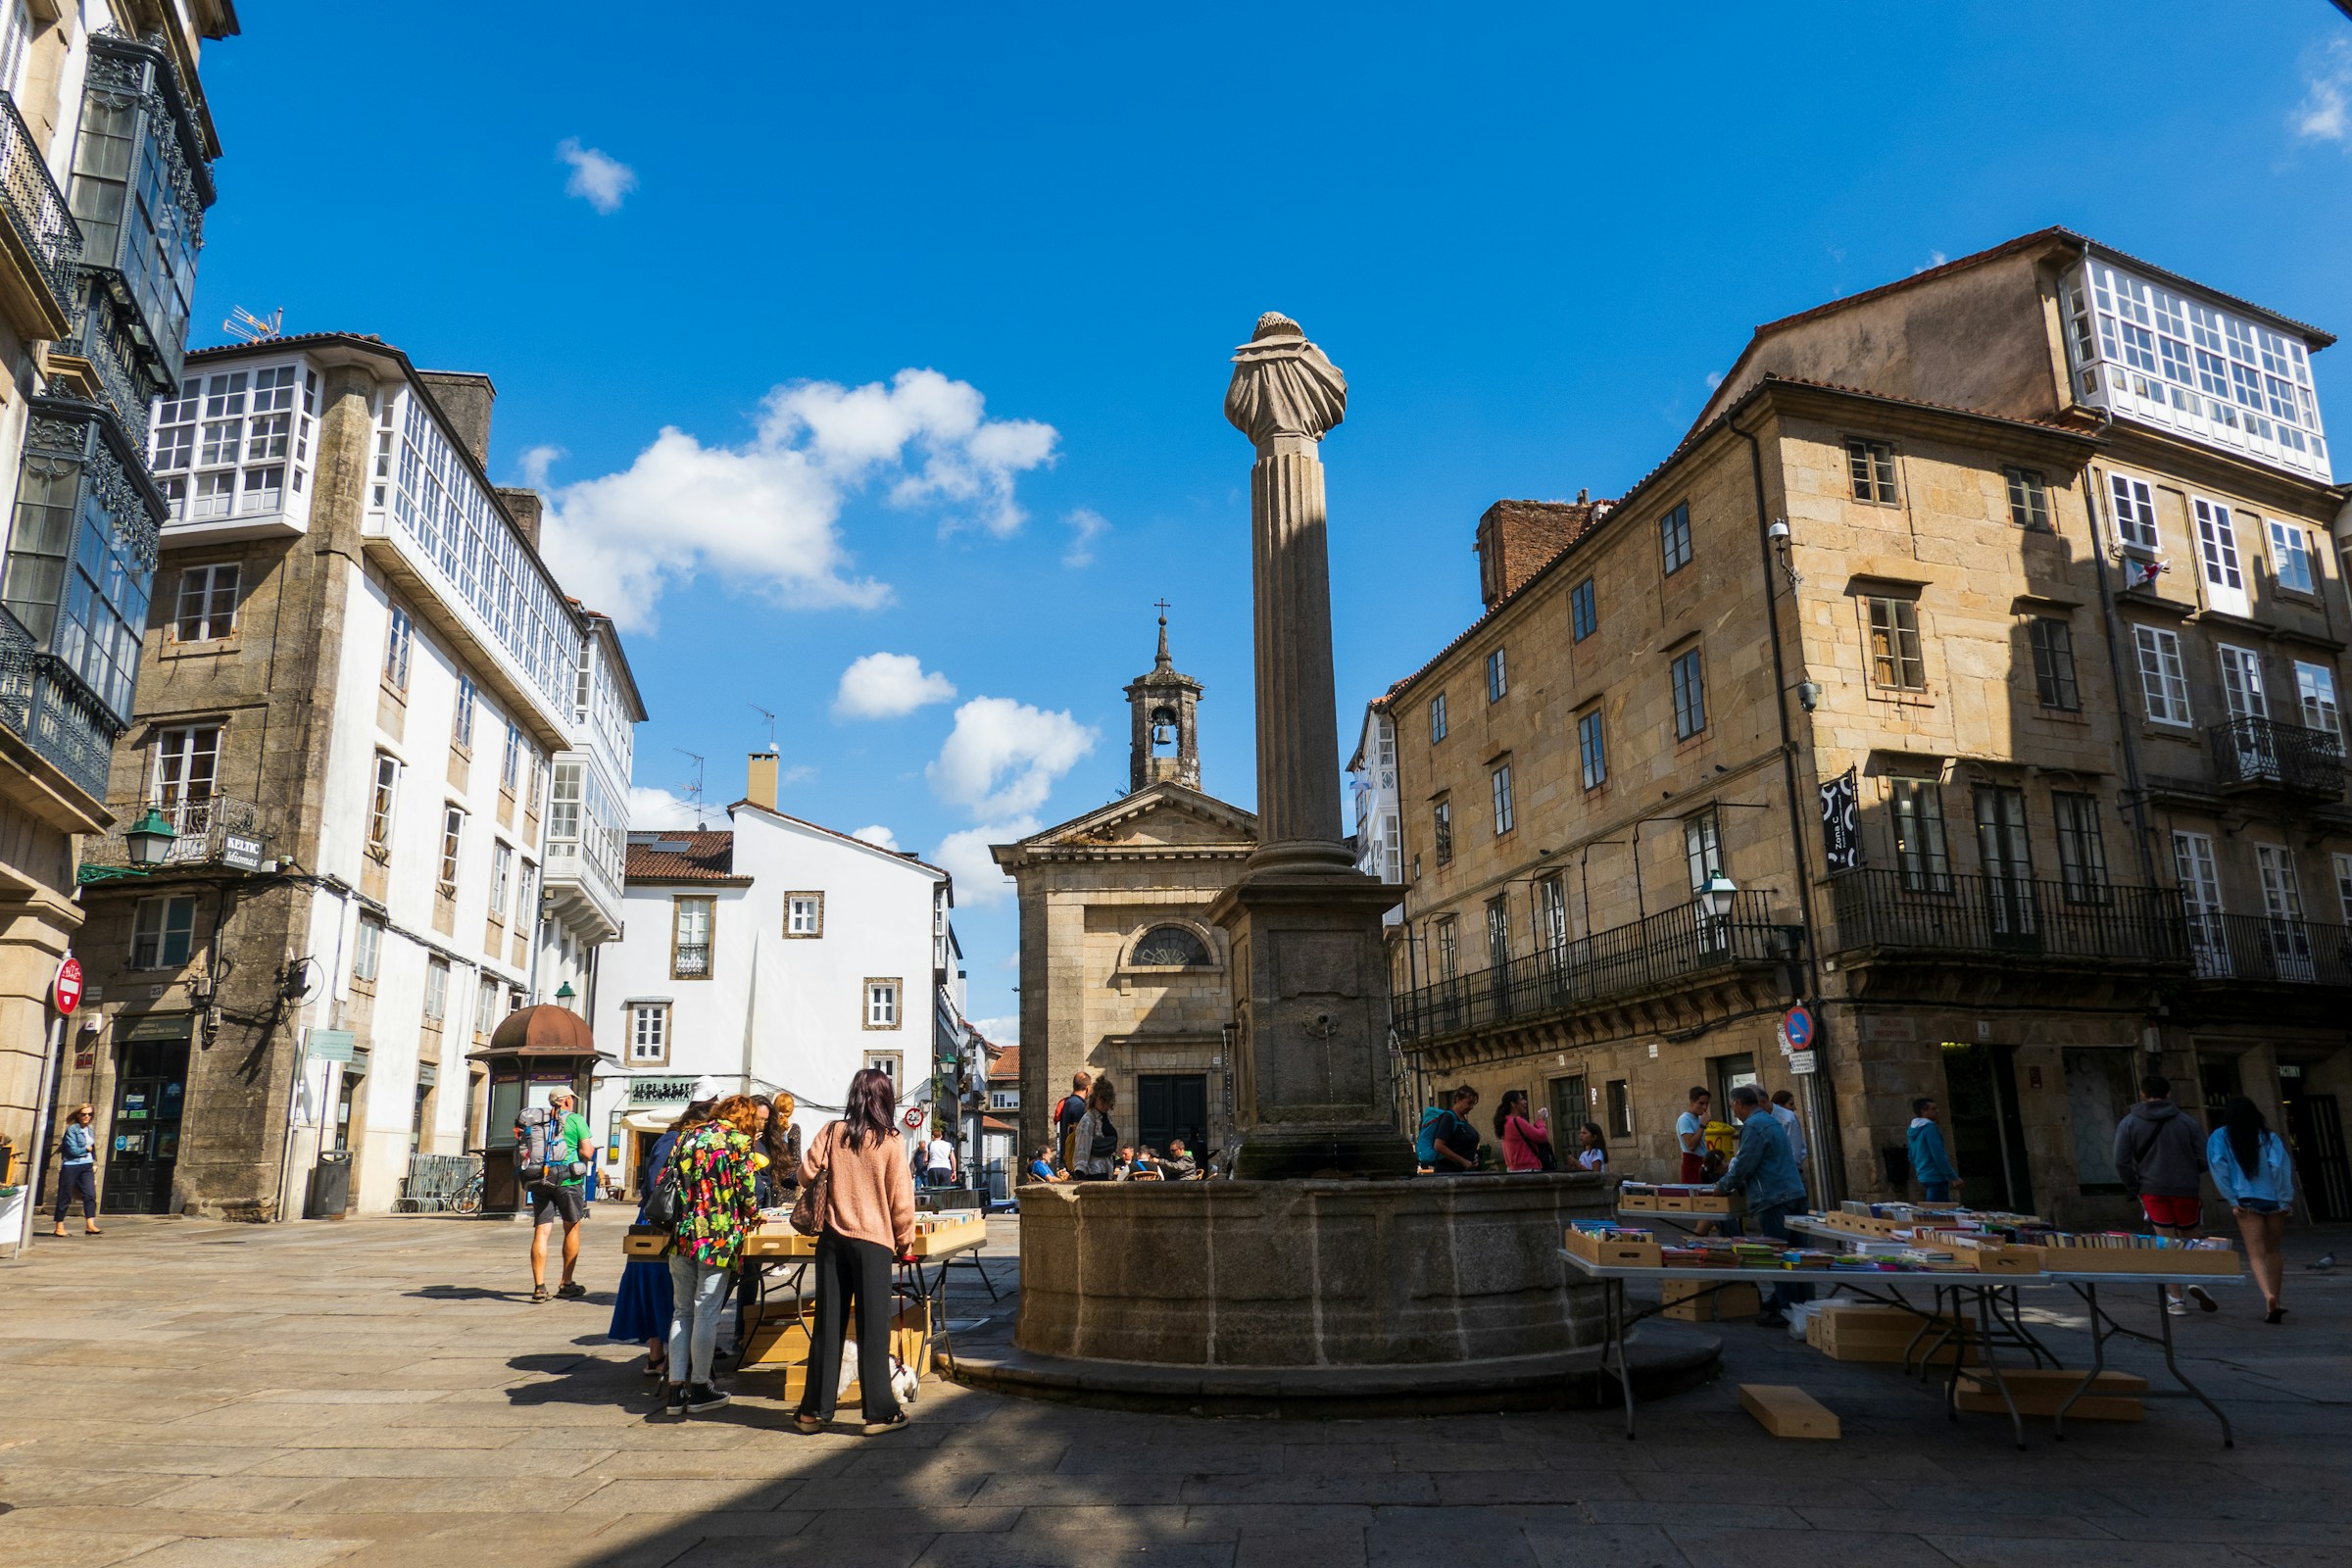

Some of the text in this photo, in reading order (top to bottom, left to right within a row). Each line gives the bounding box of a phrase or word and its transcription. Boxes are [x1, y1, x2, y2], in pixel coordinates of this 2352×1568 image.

[1832, 815, 1839, 824] C
[226, 837, 260, 855] KELTIC
[225, 851, 259, 867] Idiomas
